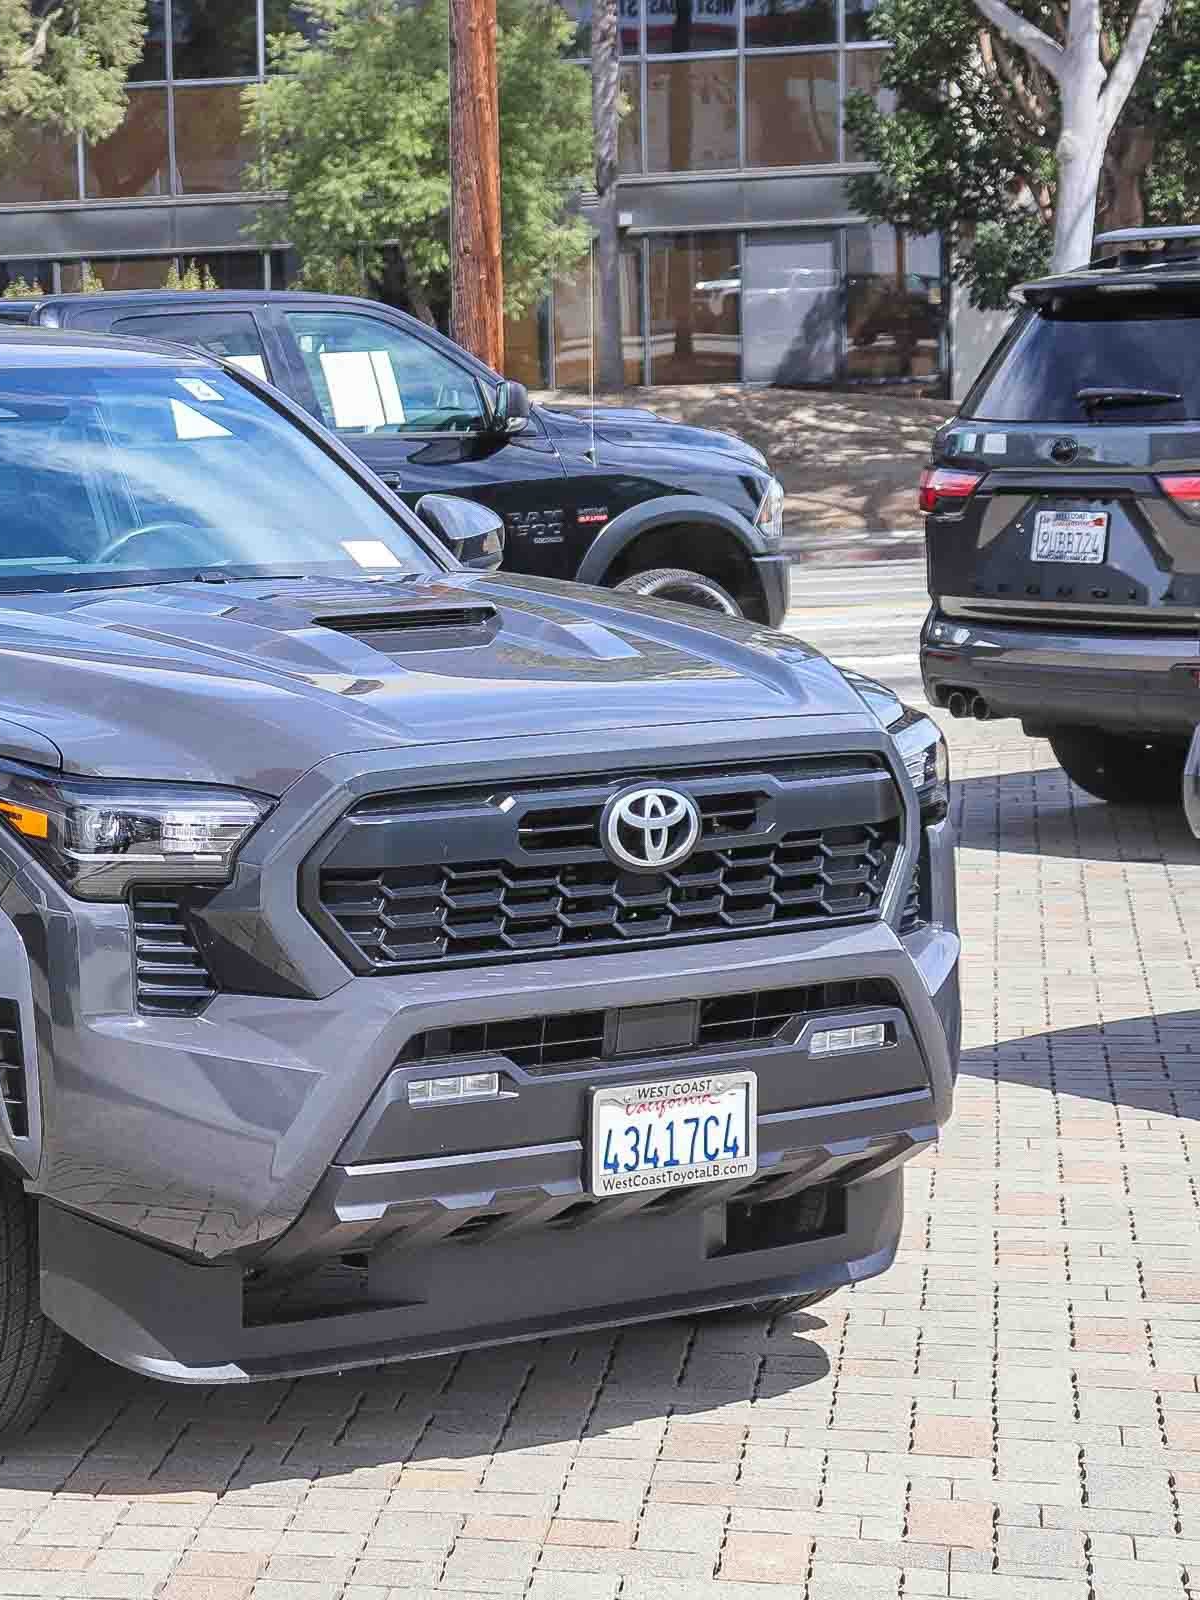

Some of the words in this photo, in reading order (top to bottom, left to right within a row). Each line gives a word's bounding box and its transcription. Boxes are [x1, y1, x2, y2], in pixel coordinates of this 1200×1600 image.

[637, 1085, 671, 1099] WEST
[673, 1080, 712, 1095] COAST
[603, 1112, 740, 1175] 43417C4
[602, 1163, 749, 1191] WestCoastToyotaLB.com
